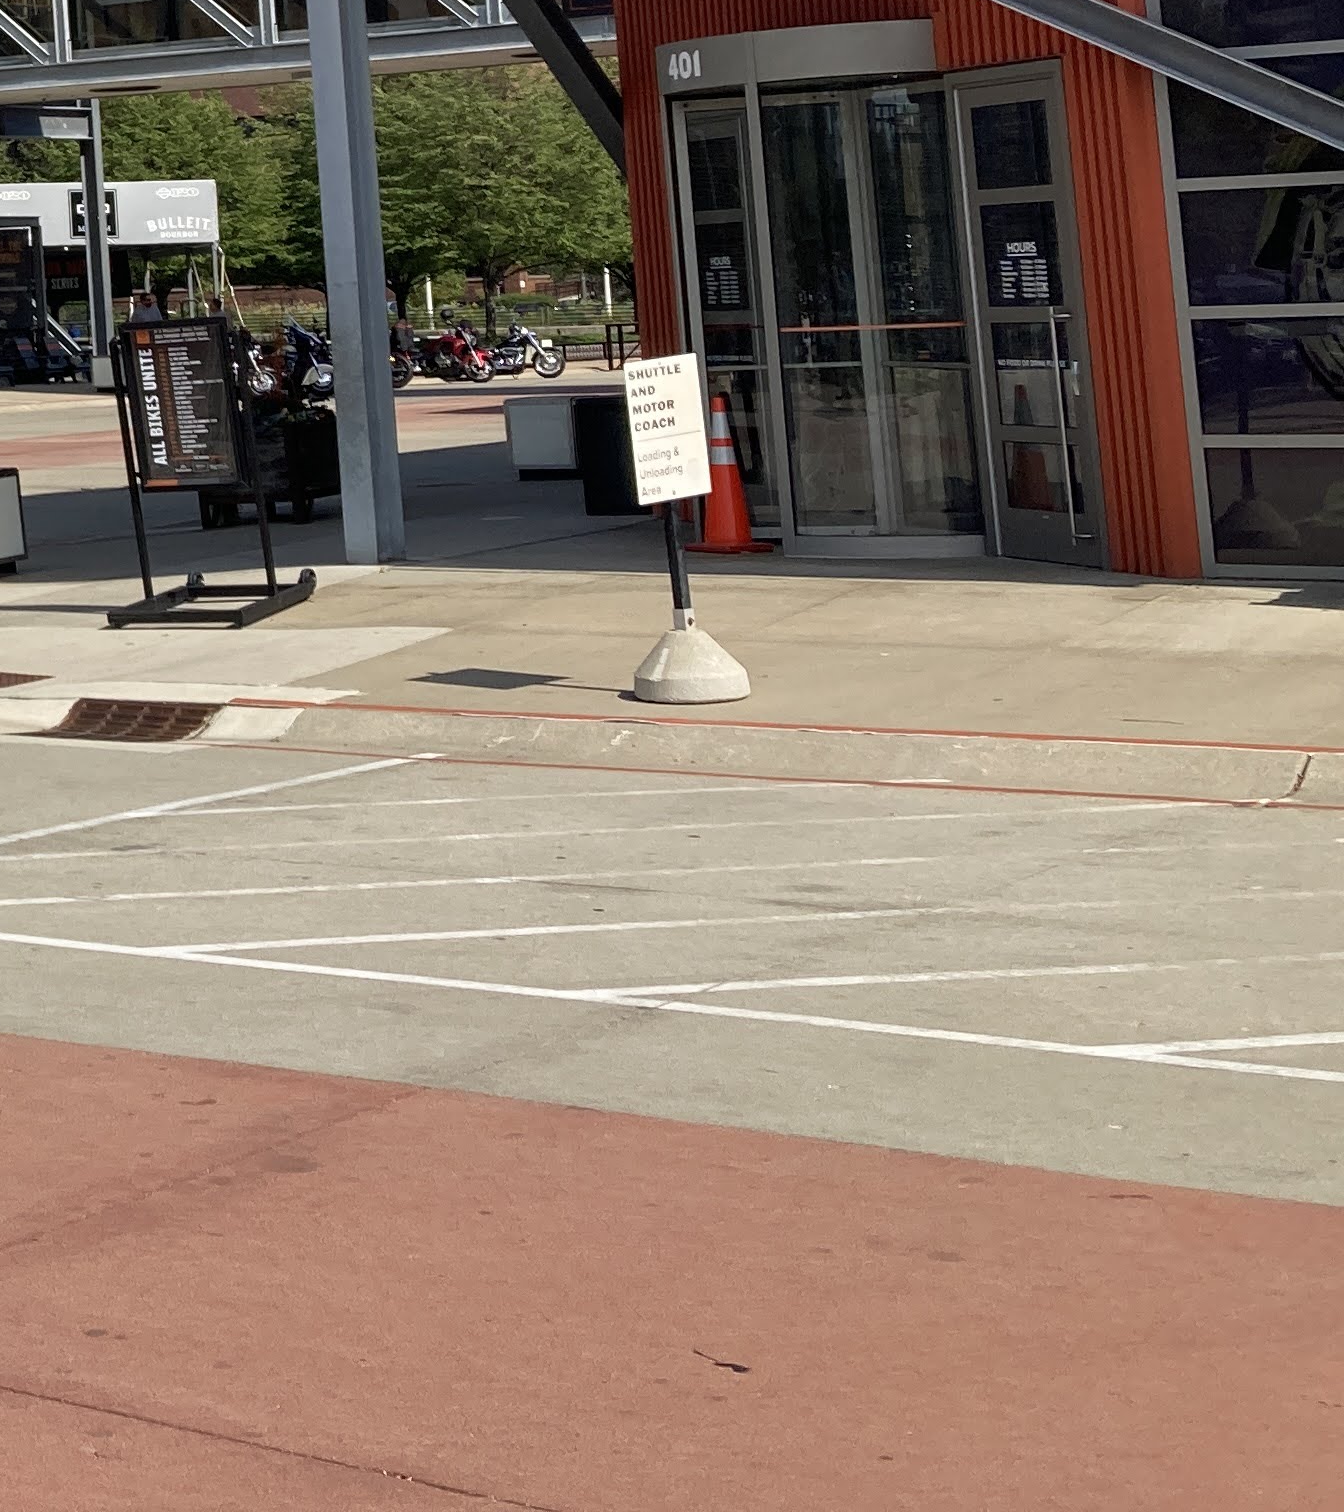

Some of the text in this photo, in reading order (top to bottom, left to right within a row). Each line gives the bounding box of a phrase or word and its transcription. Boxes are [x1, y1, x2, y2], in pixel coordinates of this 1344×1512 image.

[668, 49, 702, 80] 401
[146, 216, 211, 232] BULLEIT
[1006, 241, 1037, 253] HOURS
[709, 256, 731, 265] HOURS
[138, 348, 157, 391] UNITE
[628, 363, 682, 381] SHUTTLE
[631, 385, 656, 398] AND
[632, 399, 675, 415] MOTOR
[145, 395, 164, 437] BIKES
[634, 416, 676, 432] COACH
[152, 440, 169, 466] ALL
[637, 445, 680, 463] Loading &
[639, 464, 684, 480] Unloading
[641, 486, 662, 497] Area
